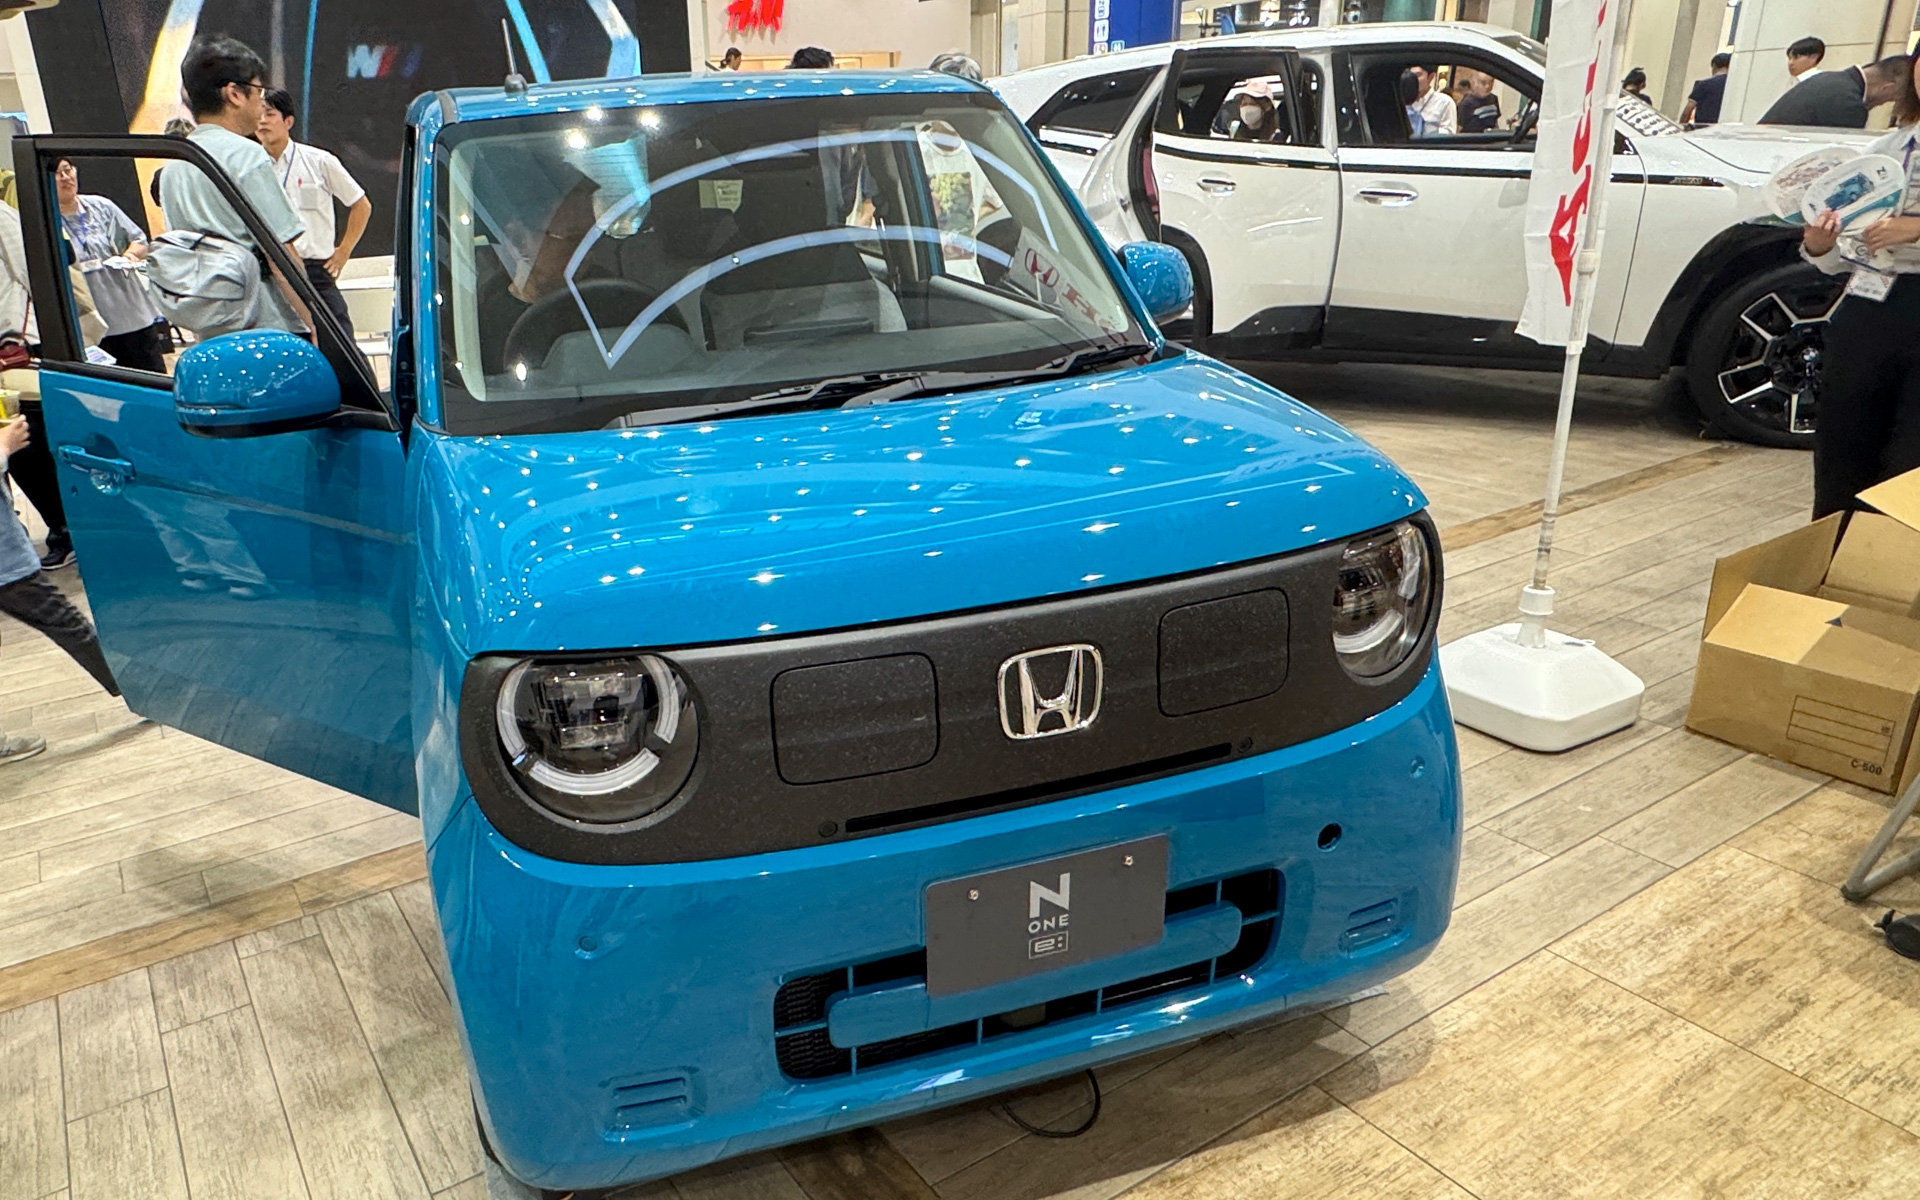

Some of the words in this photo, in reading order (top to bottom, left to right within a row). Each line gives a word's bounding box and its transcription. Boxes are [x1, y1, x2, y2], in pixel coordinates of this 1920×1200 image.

[1851, 759, 1883, 776] C-500
[1029, 872, 1070, 919] N
[1028, 914, 1069, 934] ONE
